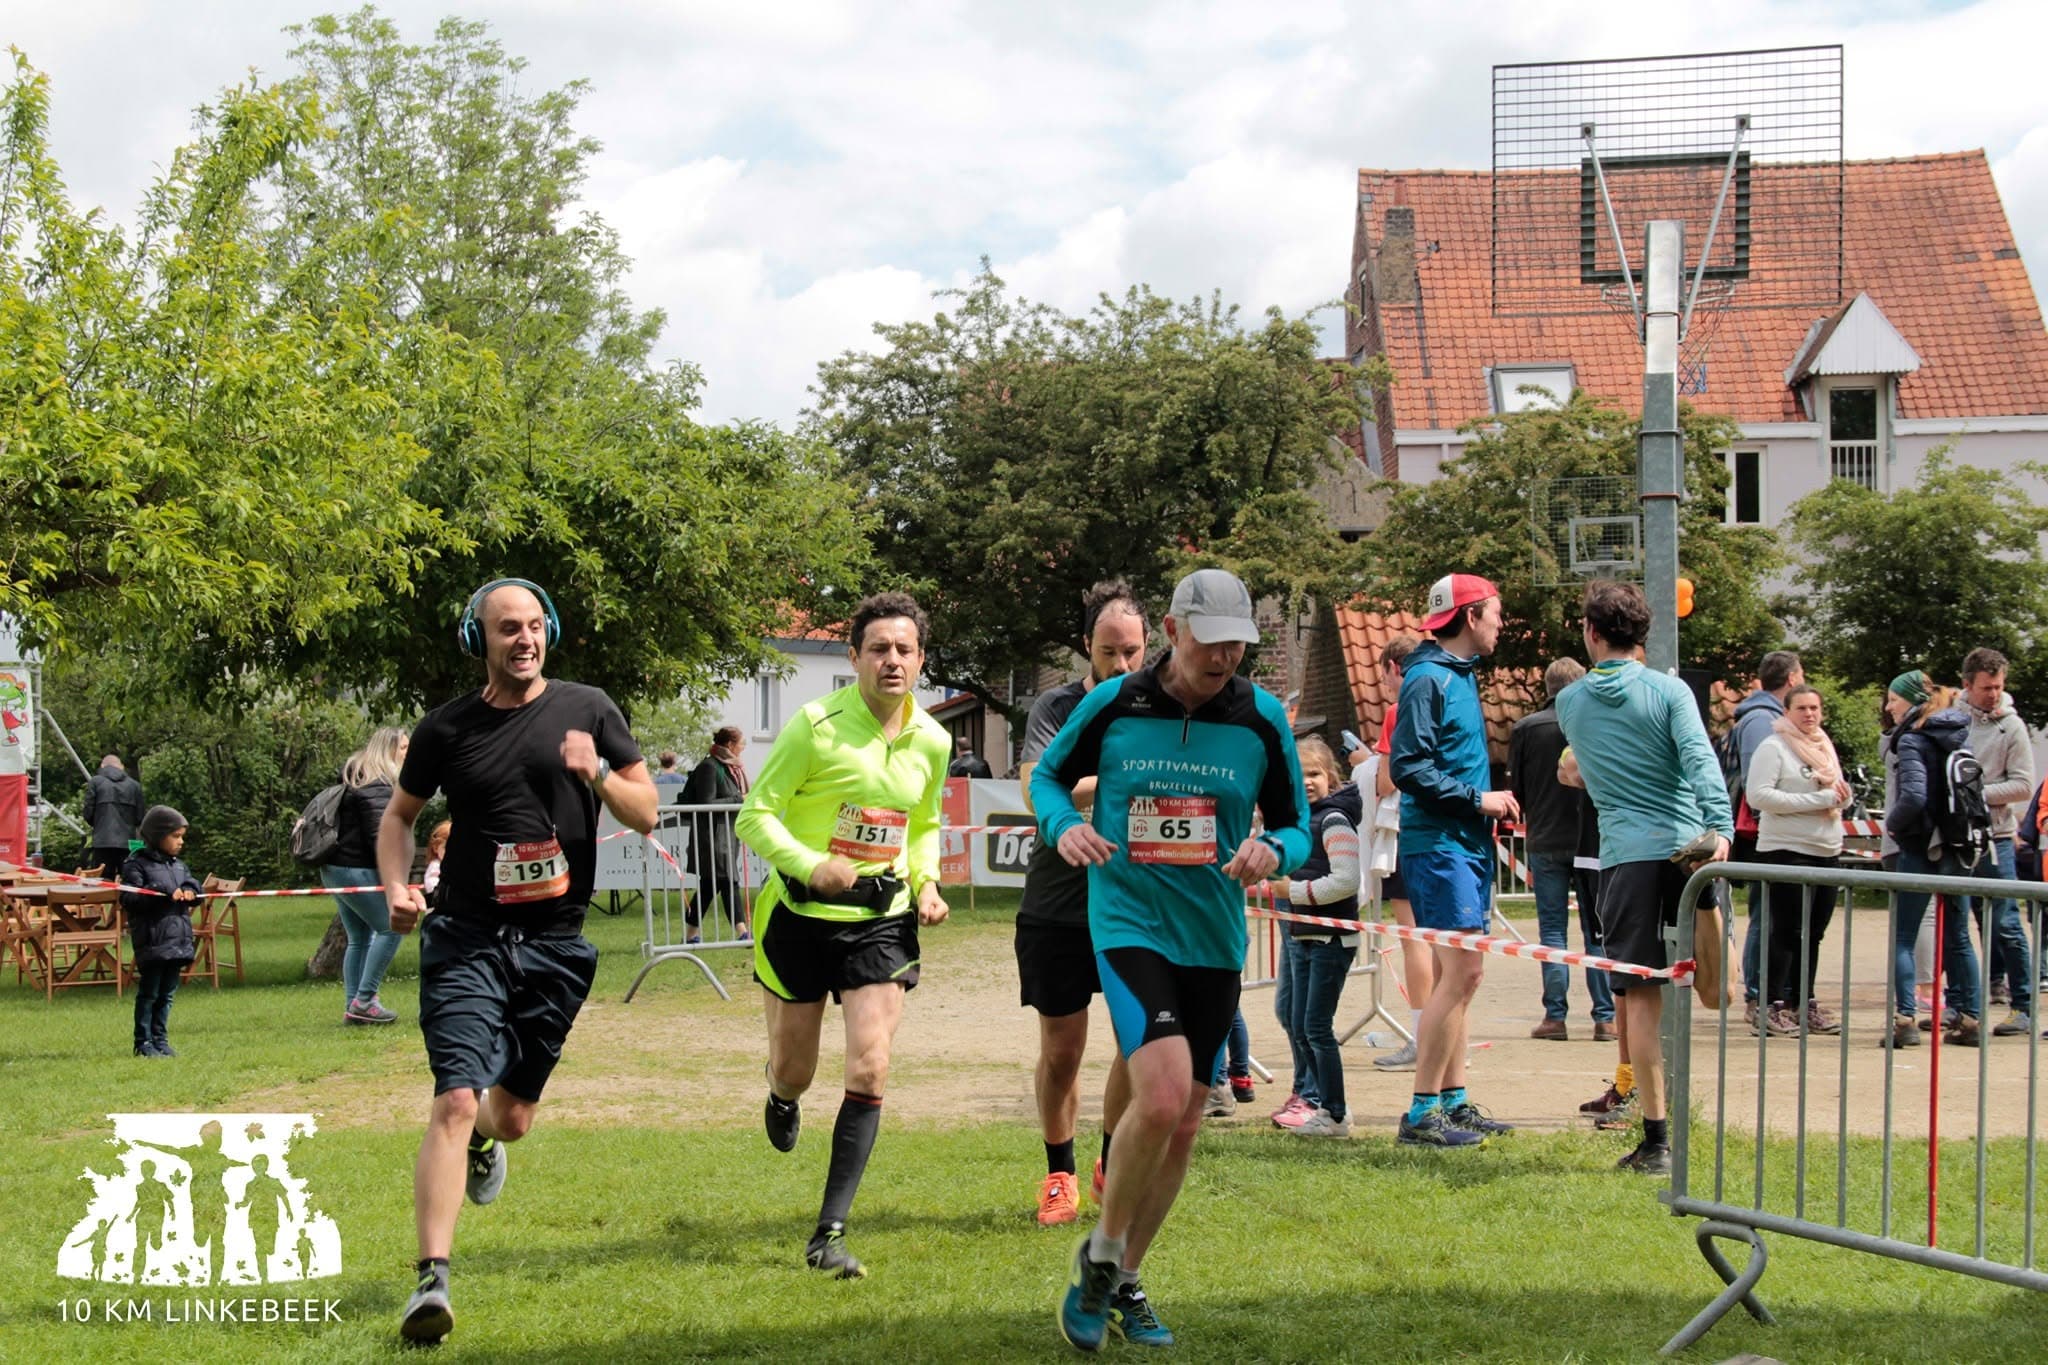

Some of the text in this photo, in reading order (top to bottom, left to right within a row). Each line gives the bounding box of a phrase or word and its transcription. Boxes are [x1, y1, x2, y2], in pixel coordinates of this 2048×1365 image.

[1123, 760, 1236, 780] SPORTIVAMENTE
[855, 825, 888, 843] 151
[1160, 819, 1191, 839] 65
[515, 860, 556, 881] 191
